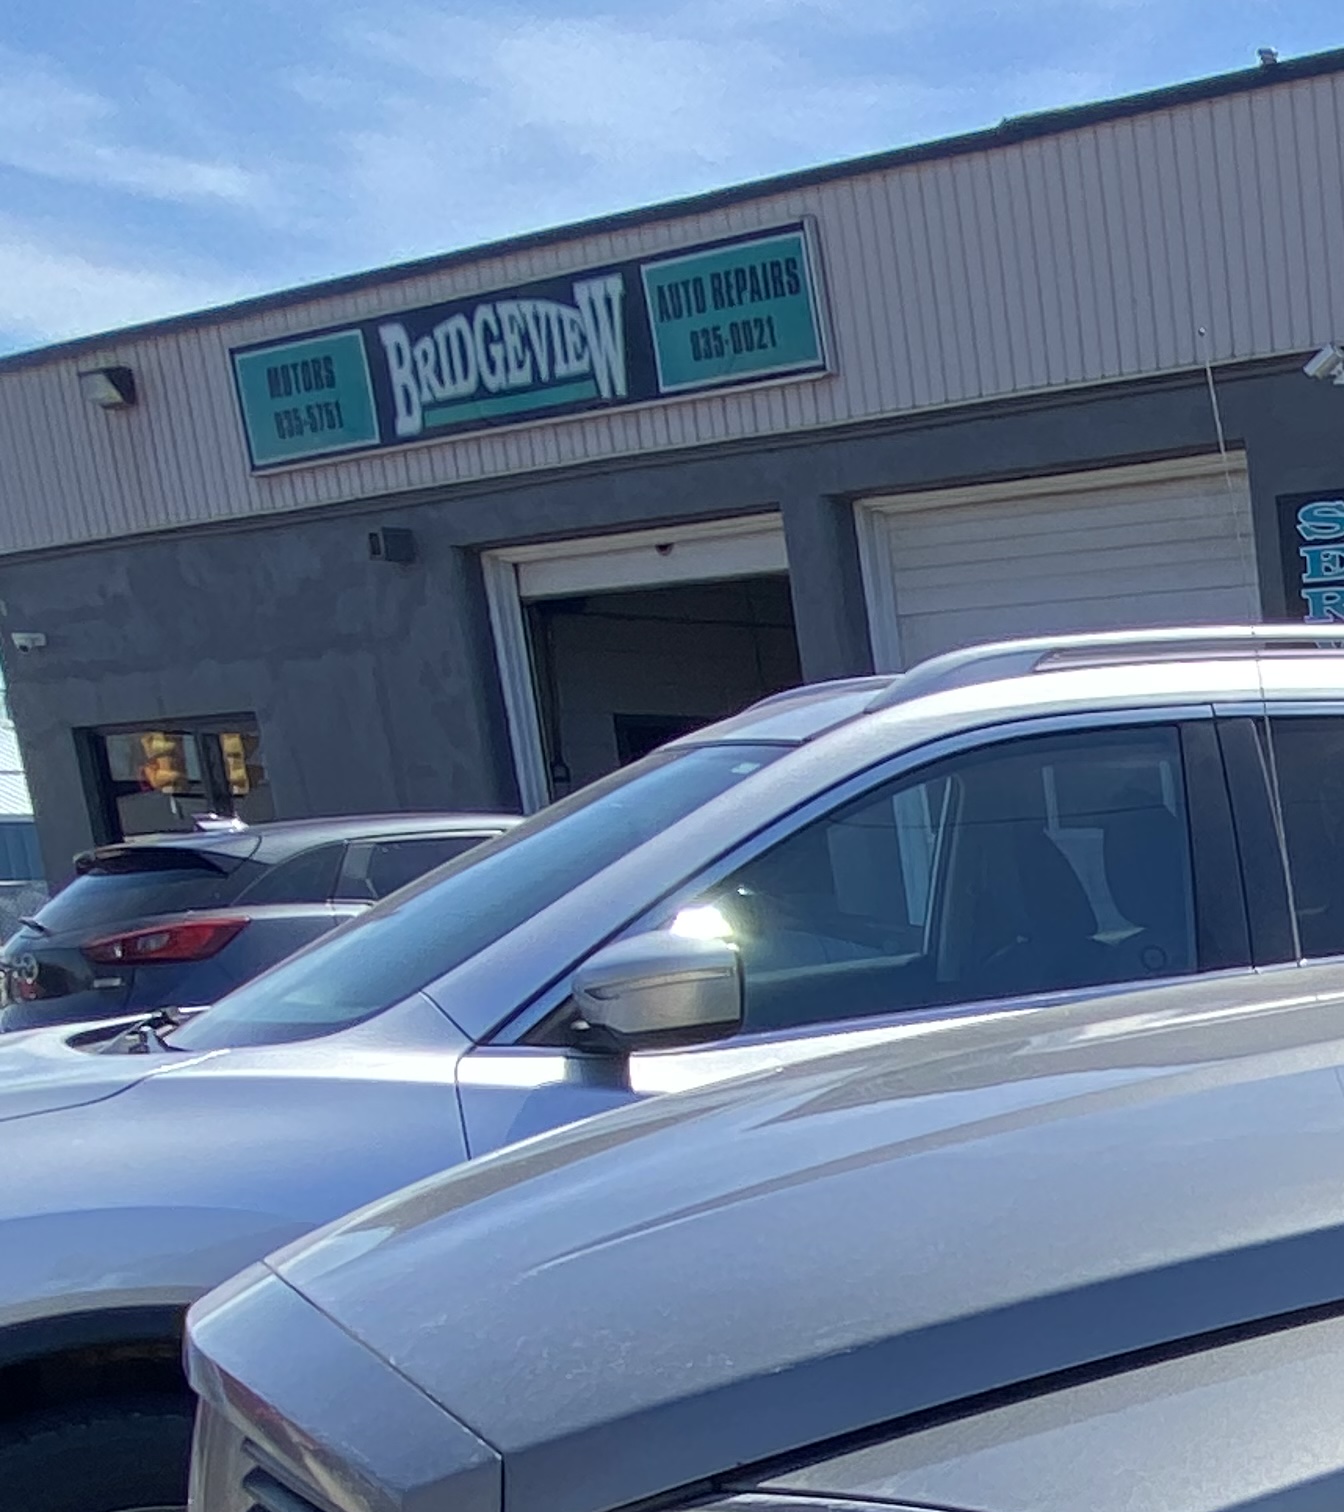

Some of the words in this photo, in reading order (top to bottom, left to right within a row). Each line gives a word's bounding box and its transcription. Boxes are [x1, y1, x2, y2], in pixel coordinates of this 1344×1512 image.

[657, 276, 706, 323] AUTO
[710, 257, 801, 311] REPAIRS
[266, 355, 336, 399] MOTORS
[379, 272, 627, 437] BRIDGEVIEW
